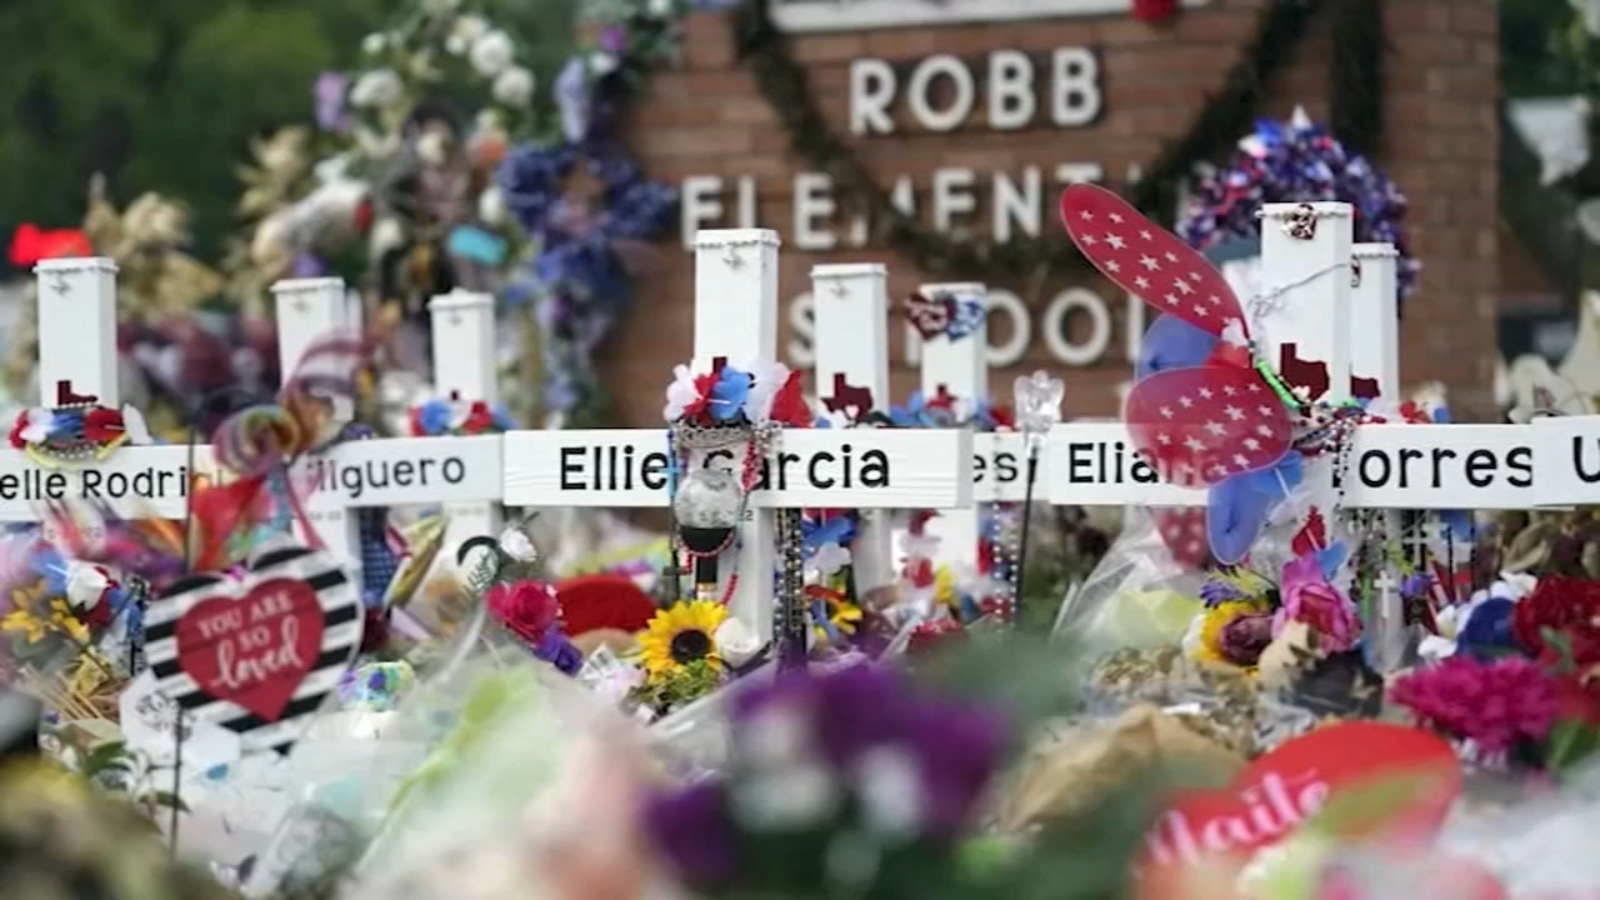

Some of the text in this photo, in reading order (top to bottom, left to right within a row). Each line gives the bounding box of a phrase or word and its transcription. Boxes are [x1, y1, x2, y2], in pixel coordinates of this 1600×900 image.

[849, 47, 1102, 136] ROBB
[786, 287, 1144, 368] SOOL
[82, 466, 223, 499] Rodri
[306, 455, 466, 499] ilguero
[560, 445, 670, 490] Ellie
[1332, 444, 1533, 488] orres
[198, 590, 294, 639] YOU ARE
[208, 614, 304, 689] loved
[238, 626, 270, 652] SO
